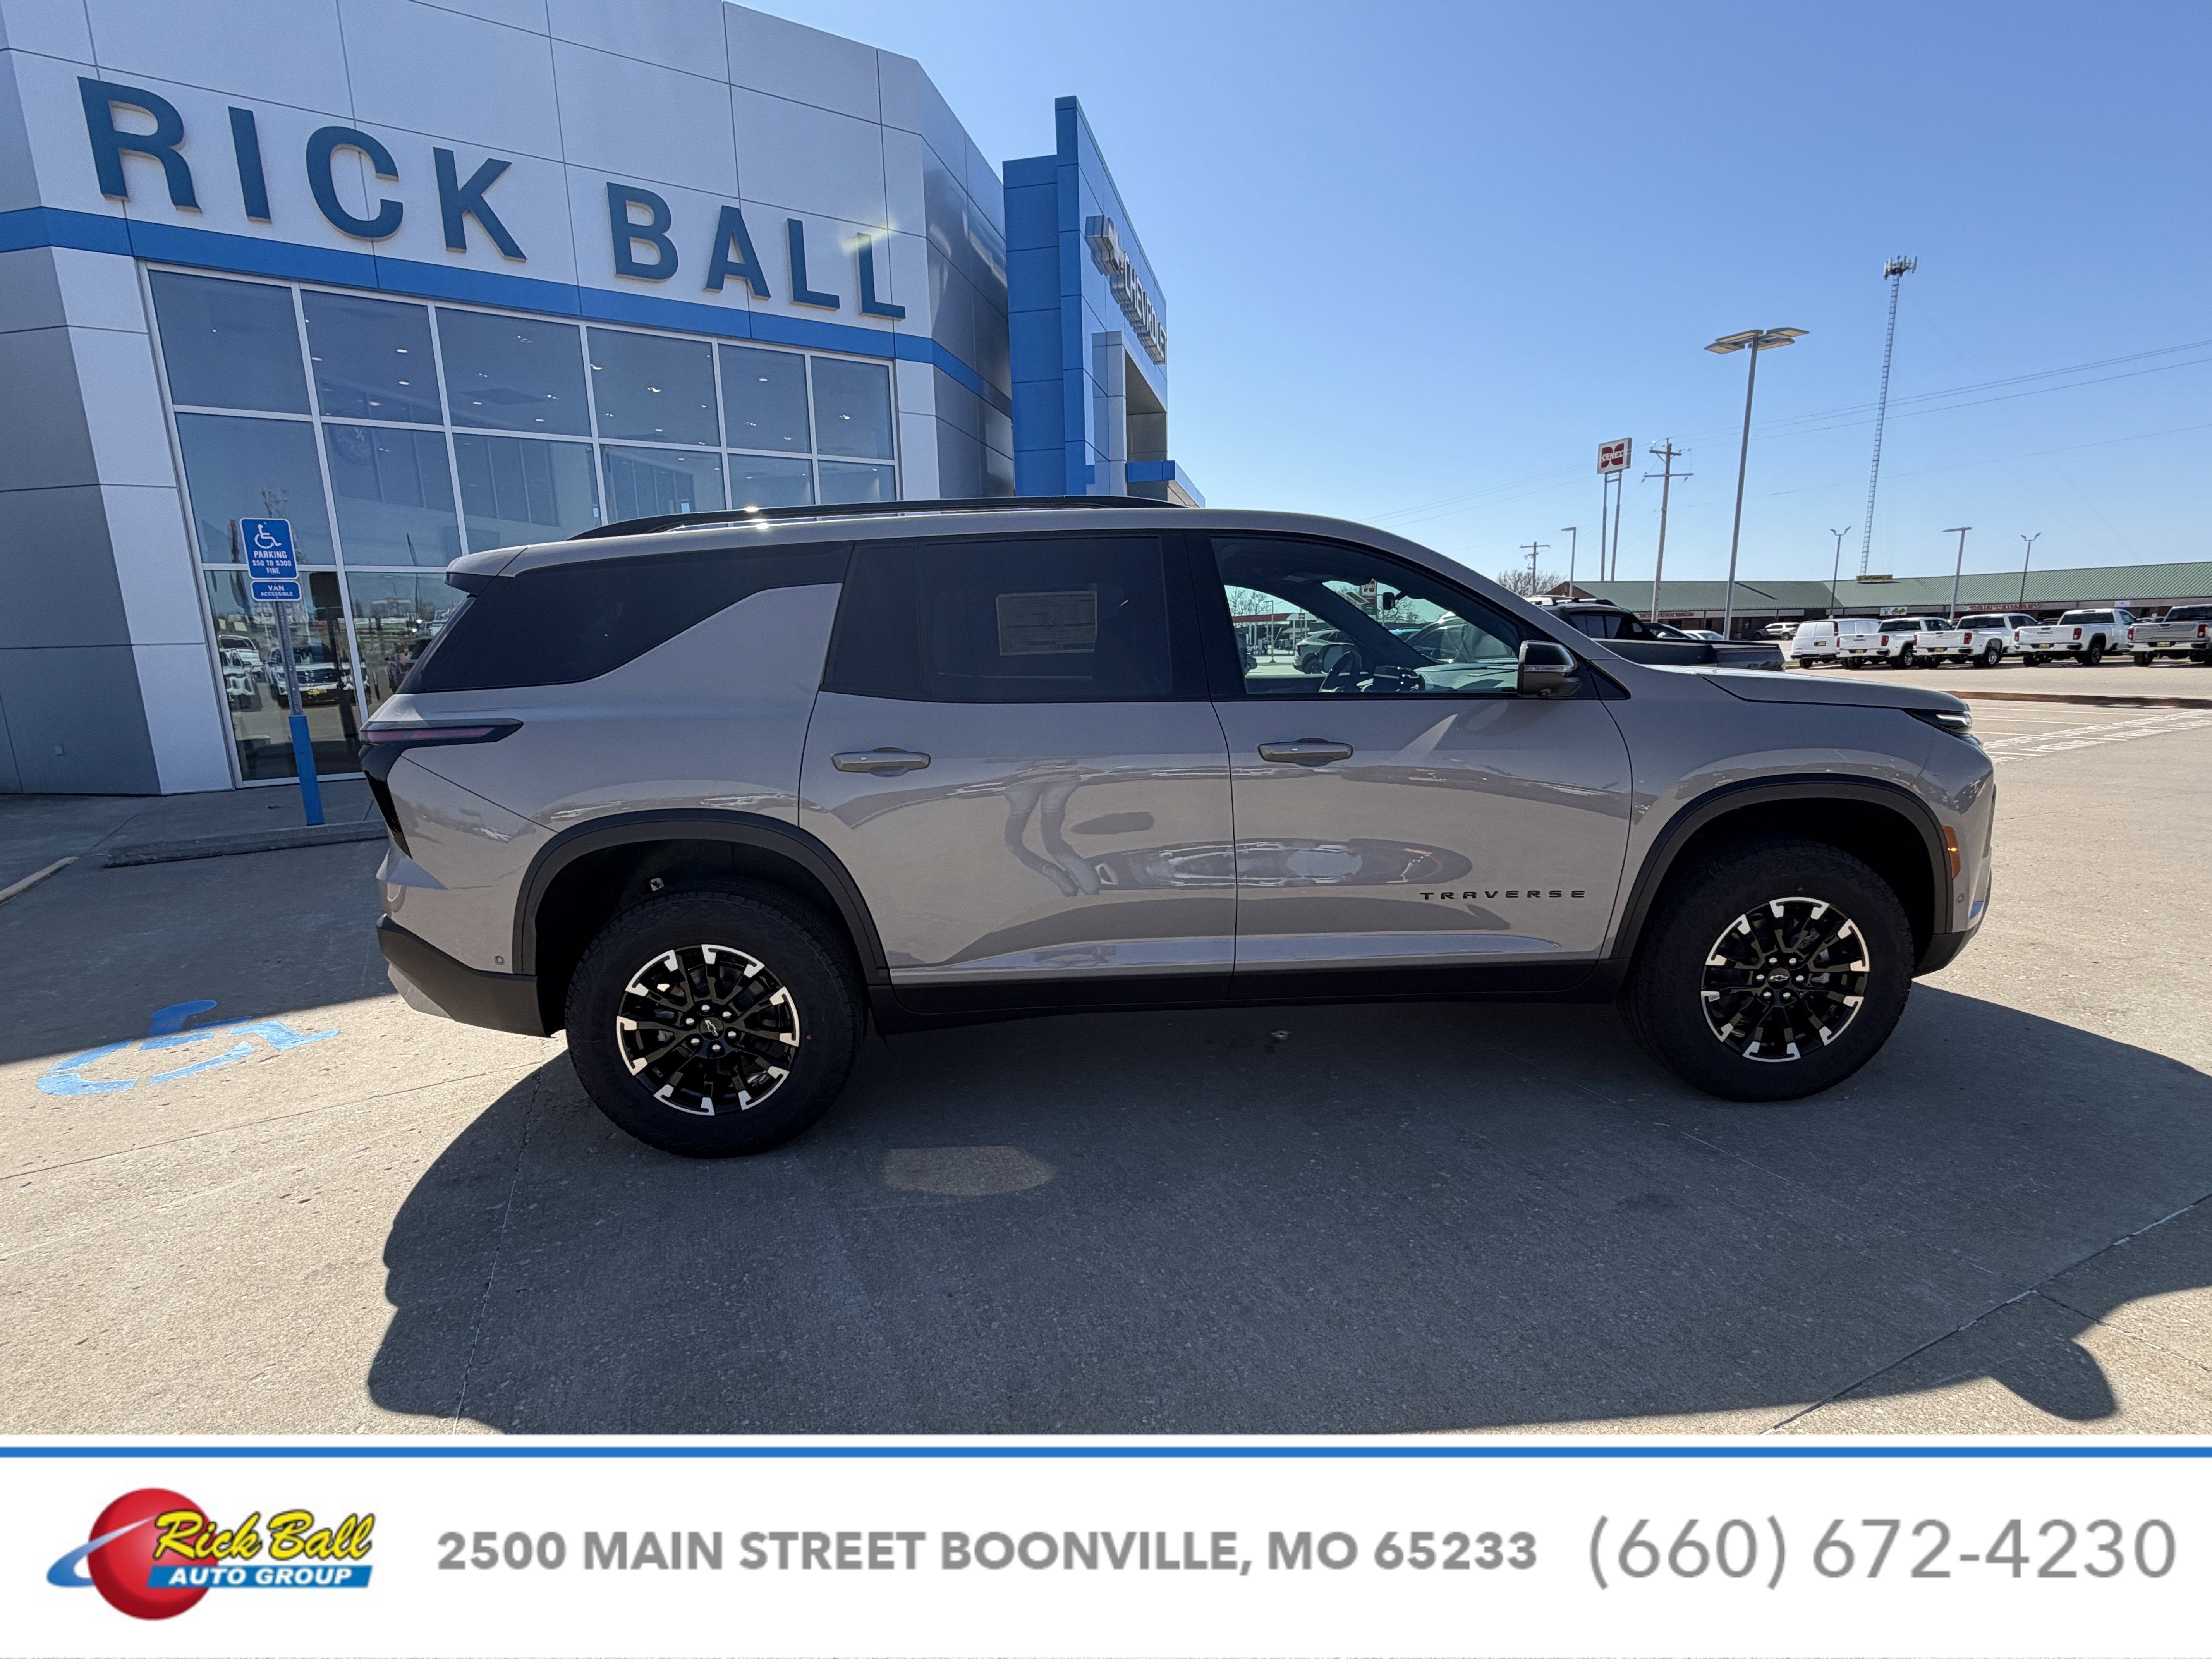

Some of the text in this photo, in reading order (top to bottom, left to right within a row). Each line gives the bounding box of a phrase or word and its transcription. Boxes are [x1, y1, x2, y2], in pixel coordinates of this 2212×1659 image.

[77, 76, 906, 321] RICK BALL
[1123, 251, 1167, 365] CHEVROLET
[254, 550, 287, 559] PARKING
[1420, 890, 1585, 900] TRAVERSE
